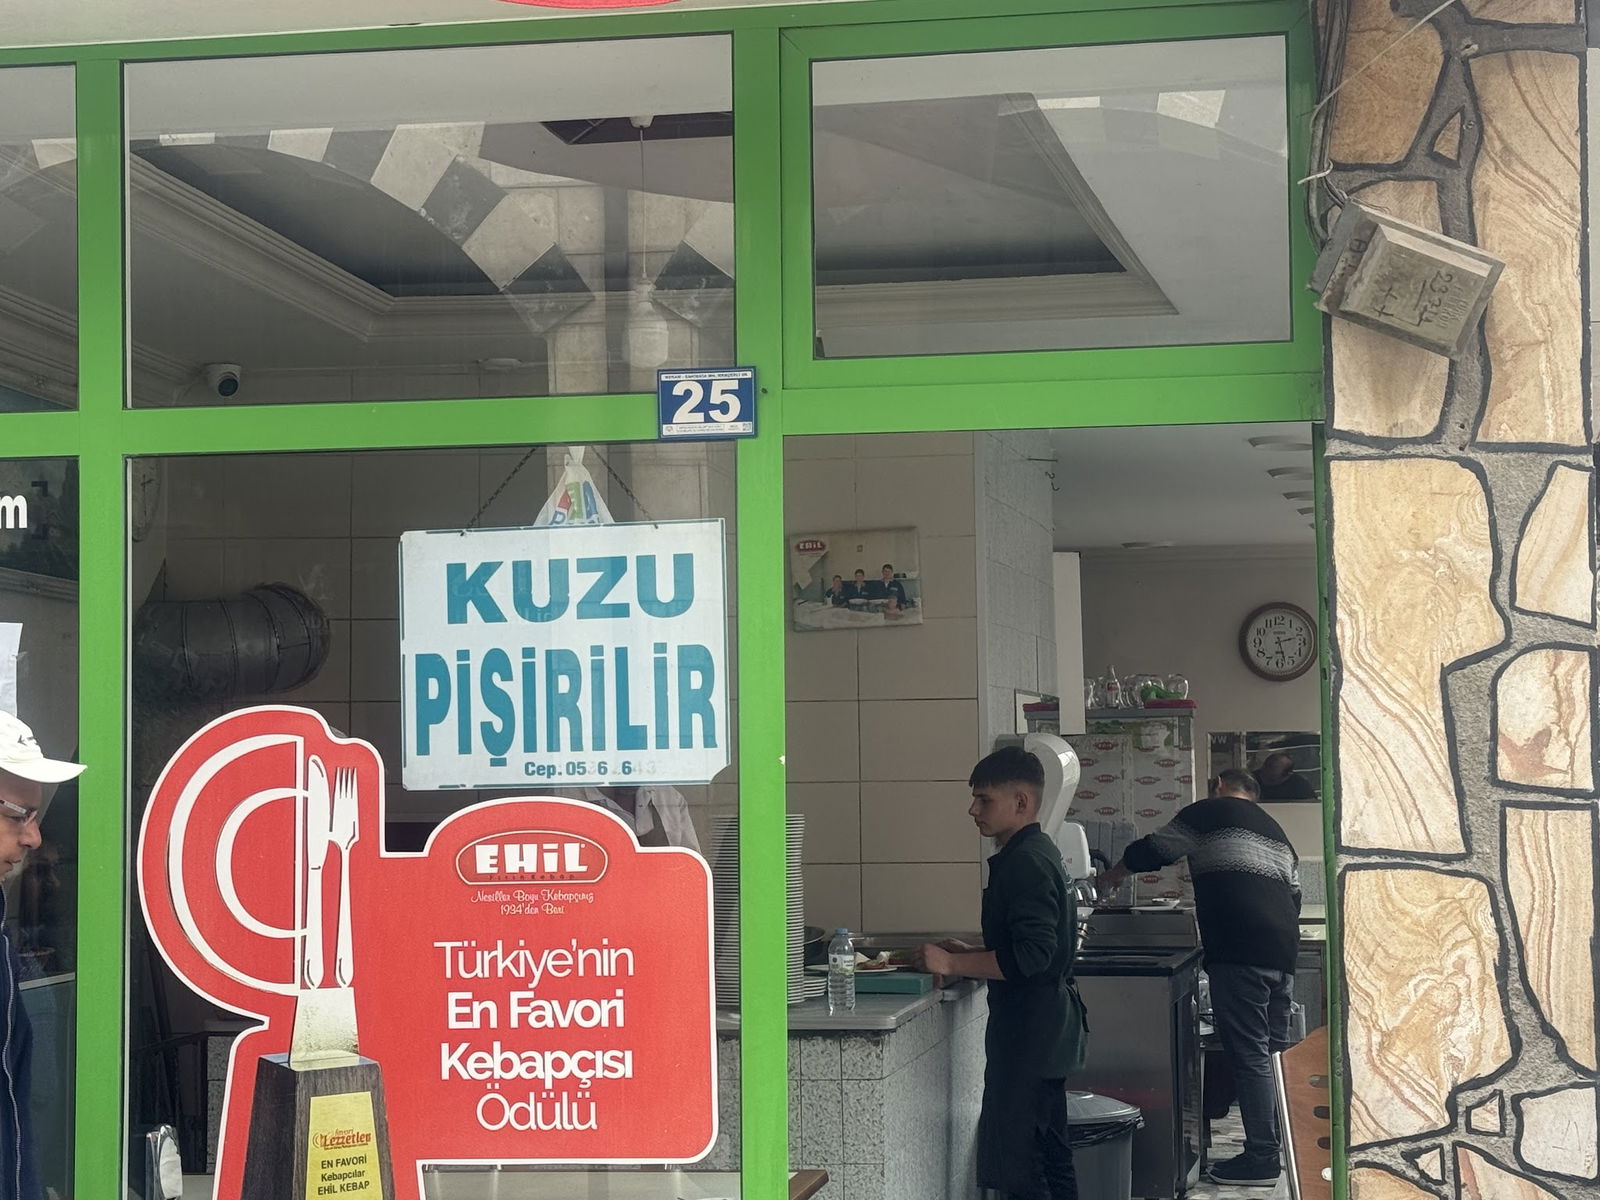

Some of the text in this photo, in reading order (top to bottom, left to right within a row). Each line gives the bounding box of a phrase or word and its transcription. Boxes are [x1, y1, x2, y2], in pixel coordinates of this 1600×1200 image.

[672, 379, 741, 423] 25
[446, 553, 695, 624] KUZU
[1265, 619, 1272, 628] 11
[1274, 615, 1285, 626] 12
[1289, 619, 1293, 629] 1
[1295, 626, 1303, 636] 2
[1253, 637, 1262, 648] 9
[1298, 637, 1306, 646] 3
[1256, 648, 1266, 658] 8
[1294, 647, 1302, 657] 4
[1266, 656, 1273, 666] 7
[1275, 659, 1284, 668] 6
[1287, 656, 1295, 666] 5
[415, 642, 718, 767] PİŞİRİLİR
[524, 761, 563, 779] Cep.
[475, 843, 588, 874] EHİL
[433, 938, 635, 989] Türkiye'nin
[447, 988, 625, 1029] En Favori
[440, 1041, 633, 1090] Kebapçısı
[476, 1083, 598, 1131] Ödülü
[321, 1160, 333, 1169] EN
[317, 1180, 370, 1196] EHİL KEBAP
